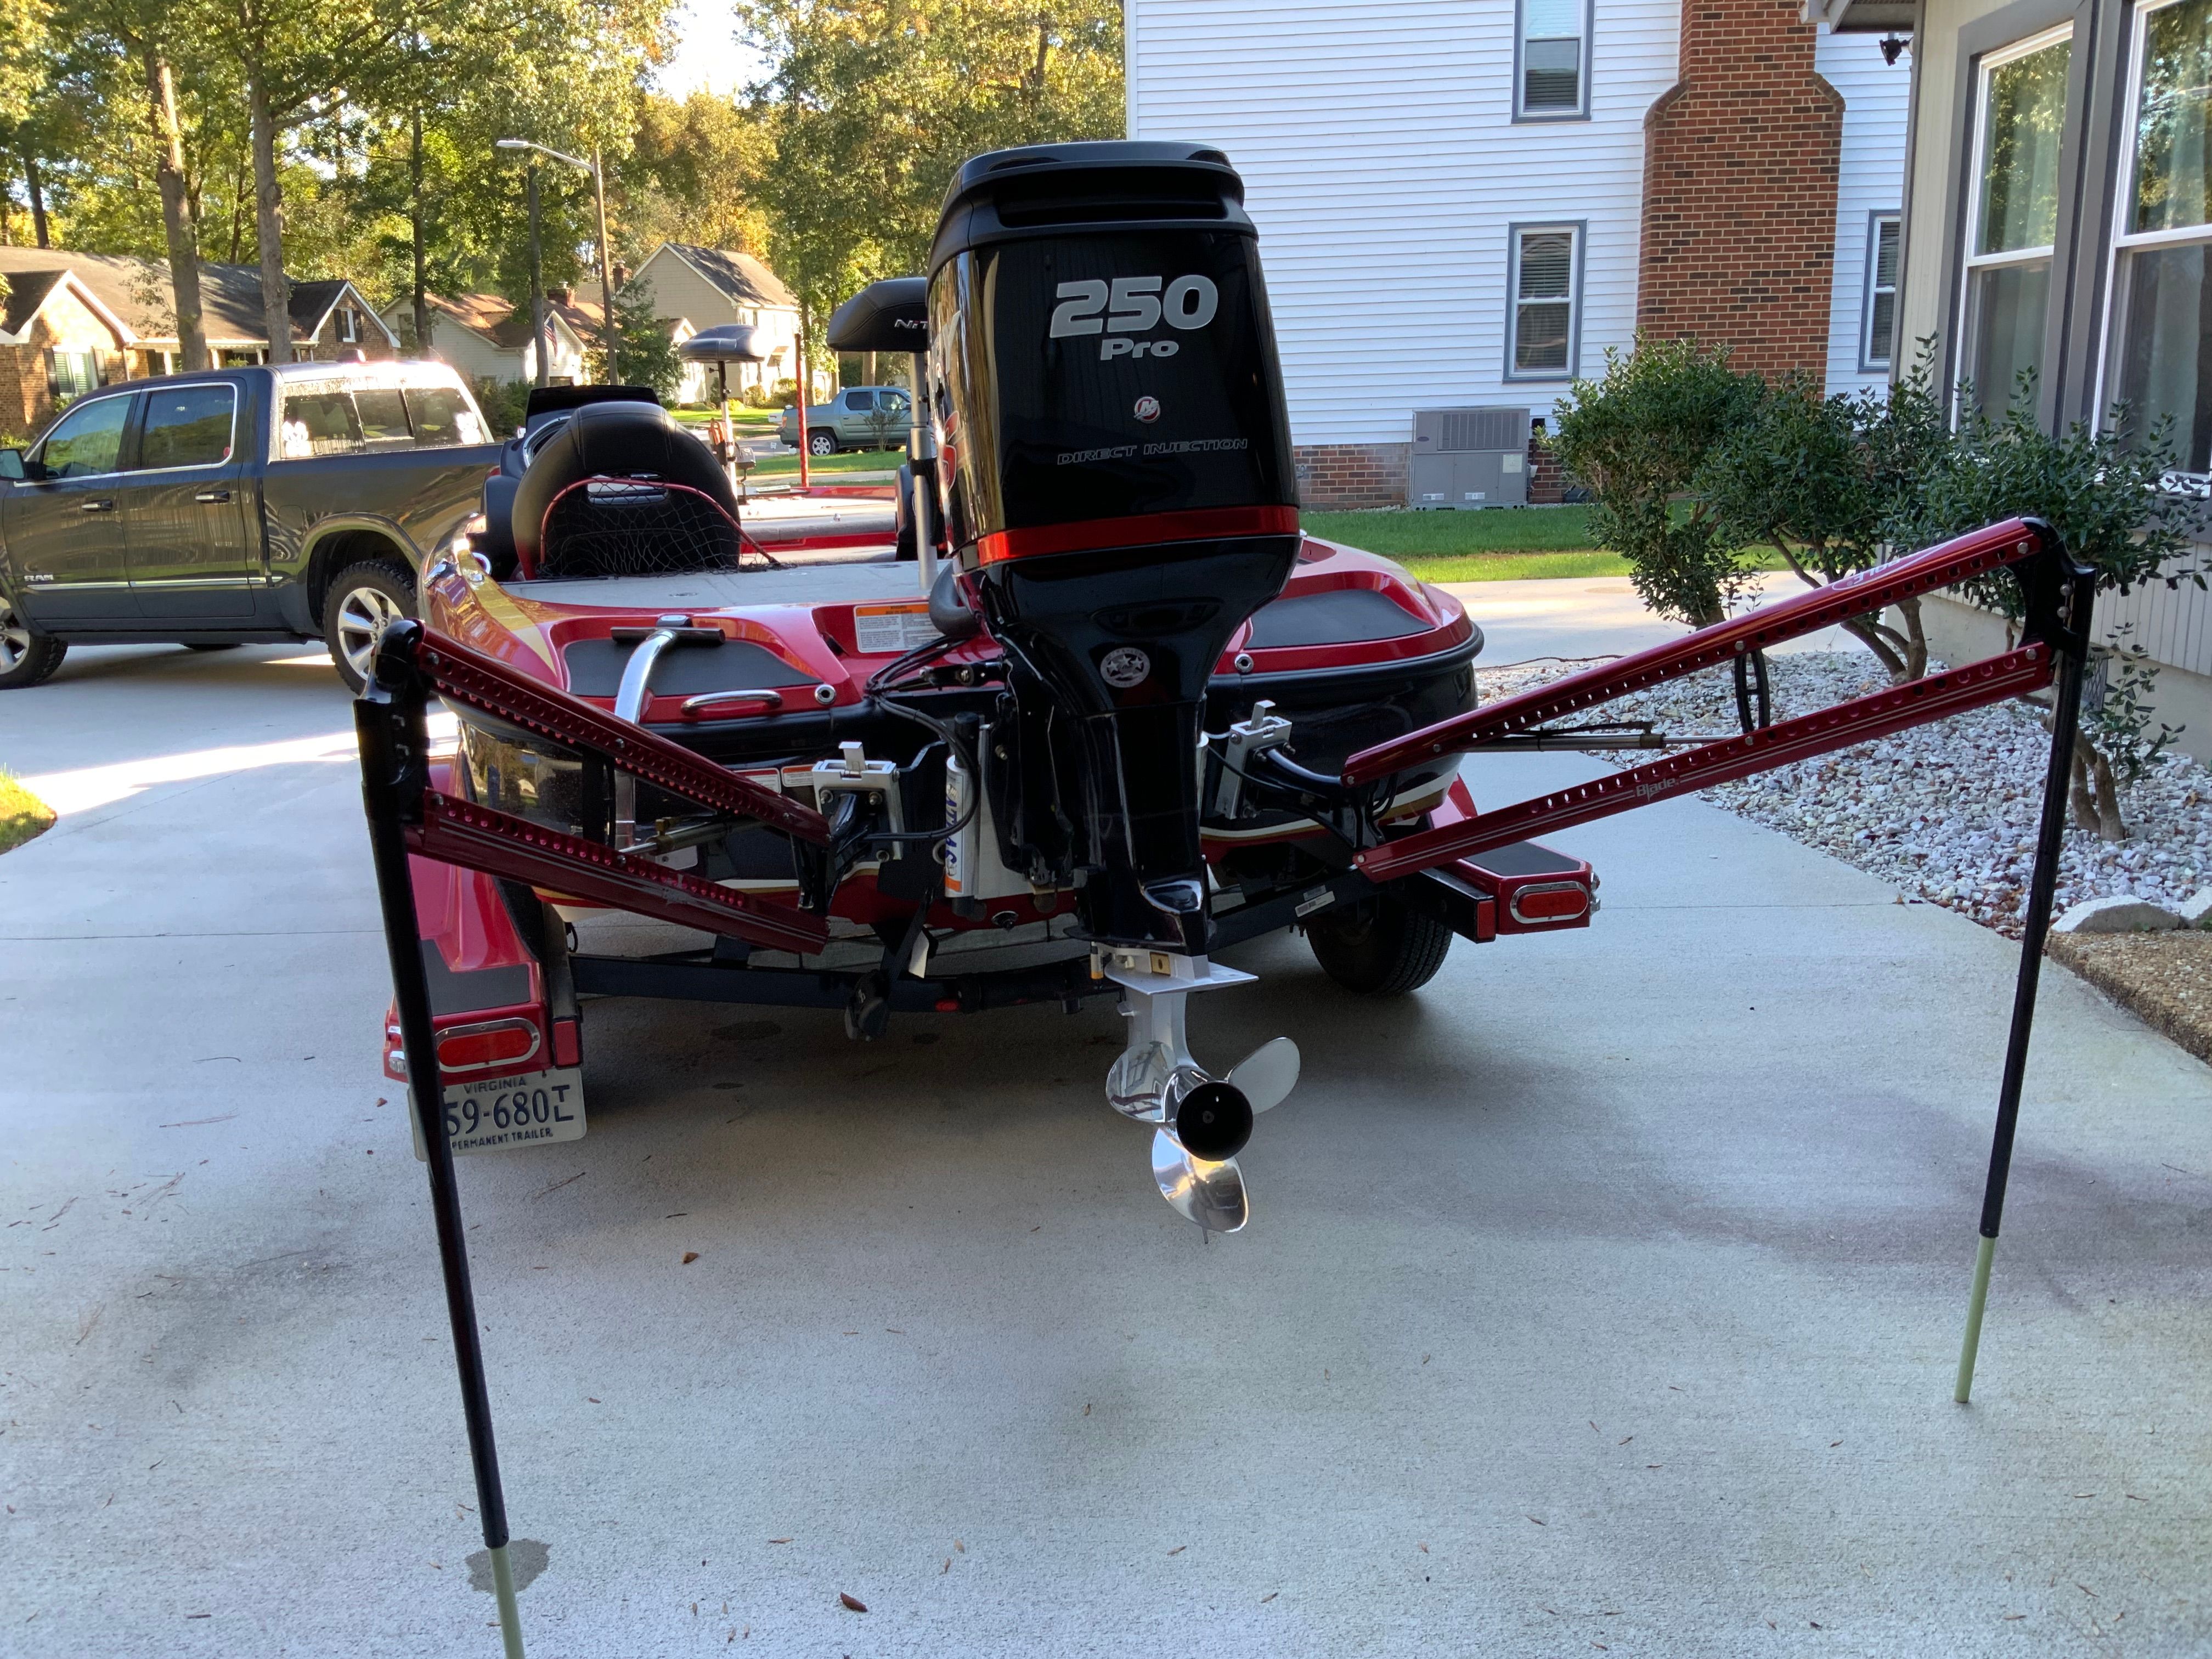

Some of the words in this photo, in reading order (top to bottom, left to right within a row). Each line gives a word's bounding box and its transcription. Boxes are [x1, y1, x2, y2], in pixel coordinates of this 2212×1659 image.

[1049, 275, 1218, 338] 250
[1101, 338, 1179, 360] Pro
[1057, 445, 1137, 465] DIRECT
[1143, 439, 1248, 455] INJECTION
[1635, 777, 1676, 802] Blade
[462, 1076, 527, 1094] VIRGINIA
[452, 1133, 509, 1150] PERMANENT
[511, 1127, 552, 1142] TRAILER
